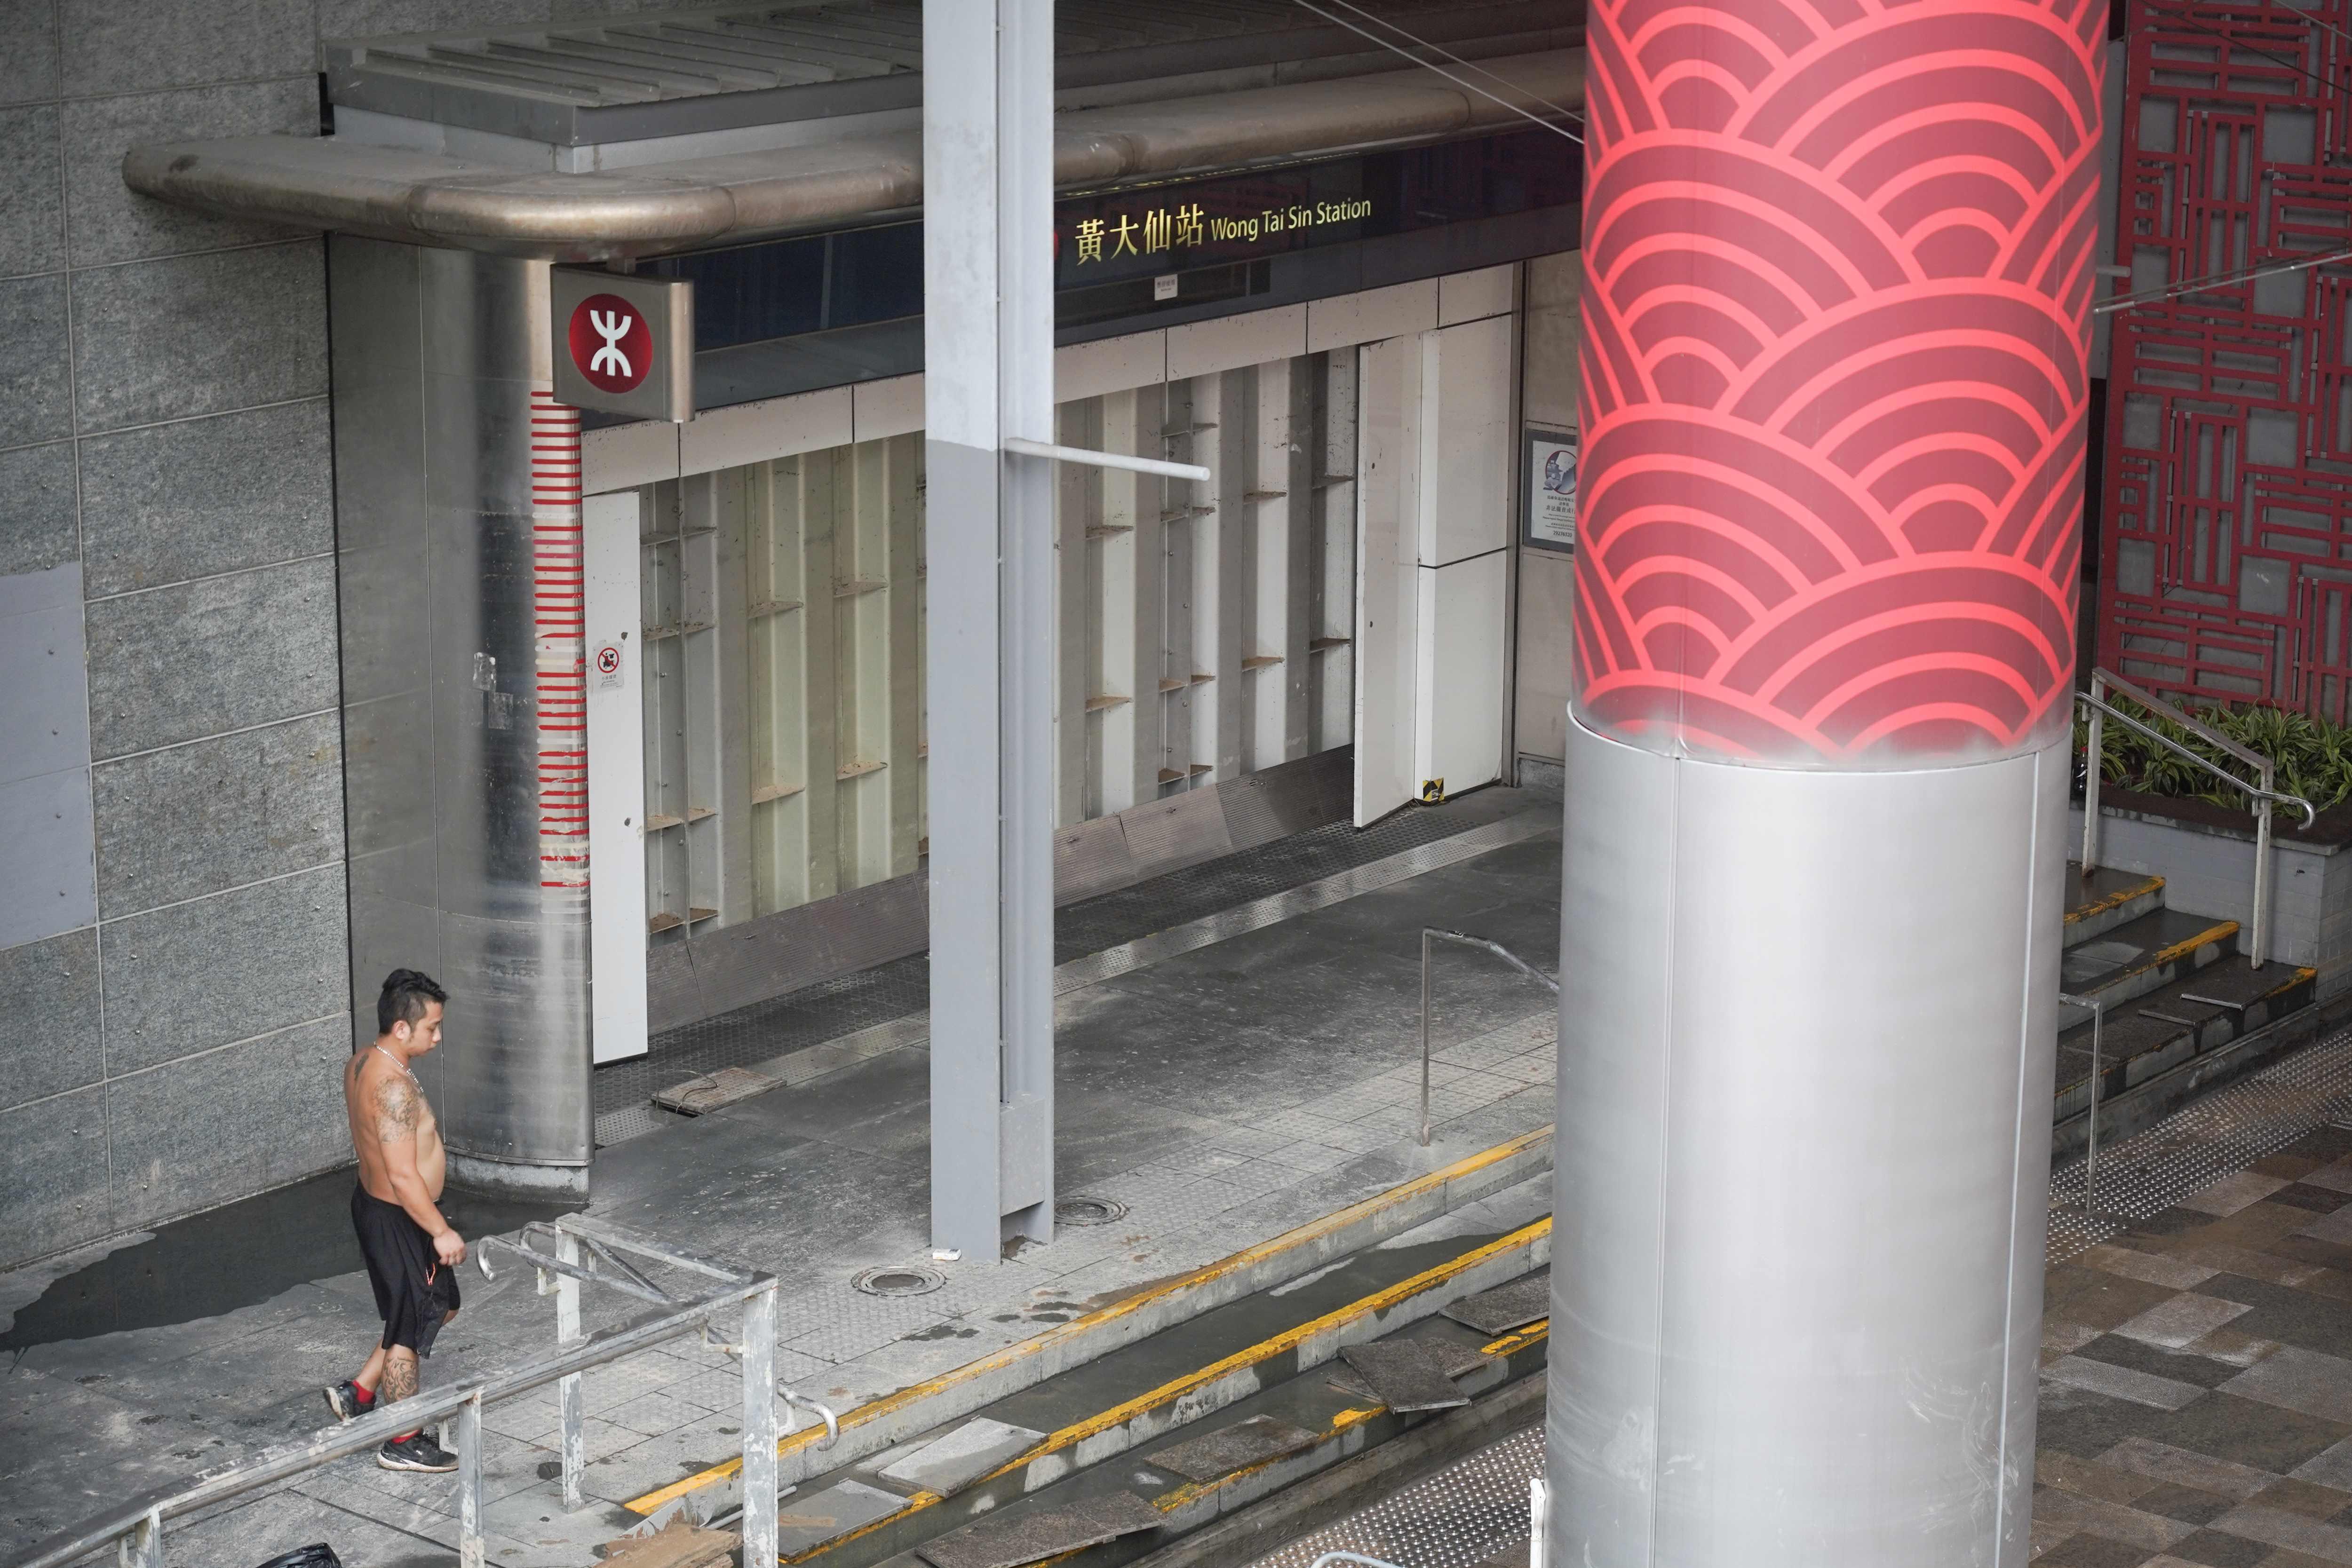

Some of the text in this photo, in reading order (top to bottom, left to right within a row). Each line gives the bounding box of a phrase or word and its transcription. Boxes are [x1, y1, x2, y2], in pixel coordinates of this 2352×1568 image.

[1075, 203, 1204, 266] 黃大仙站
[1210, 198, 1371, 242] Wong Tai Sin Station
